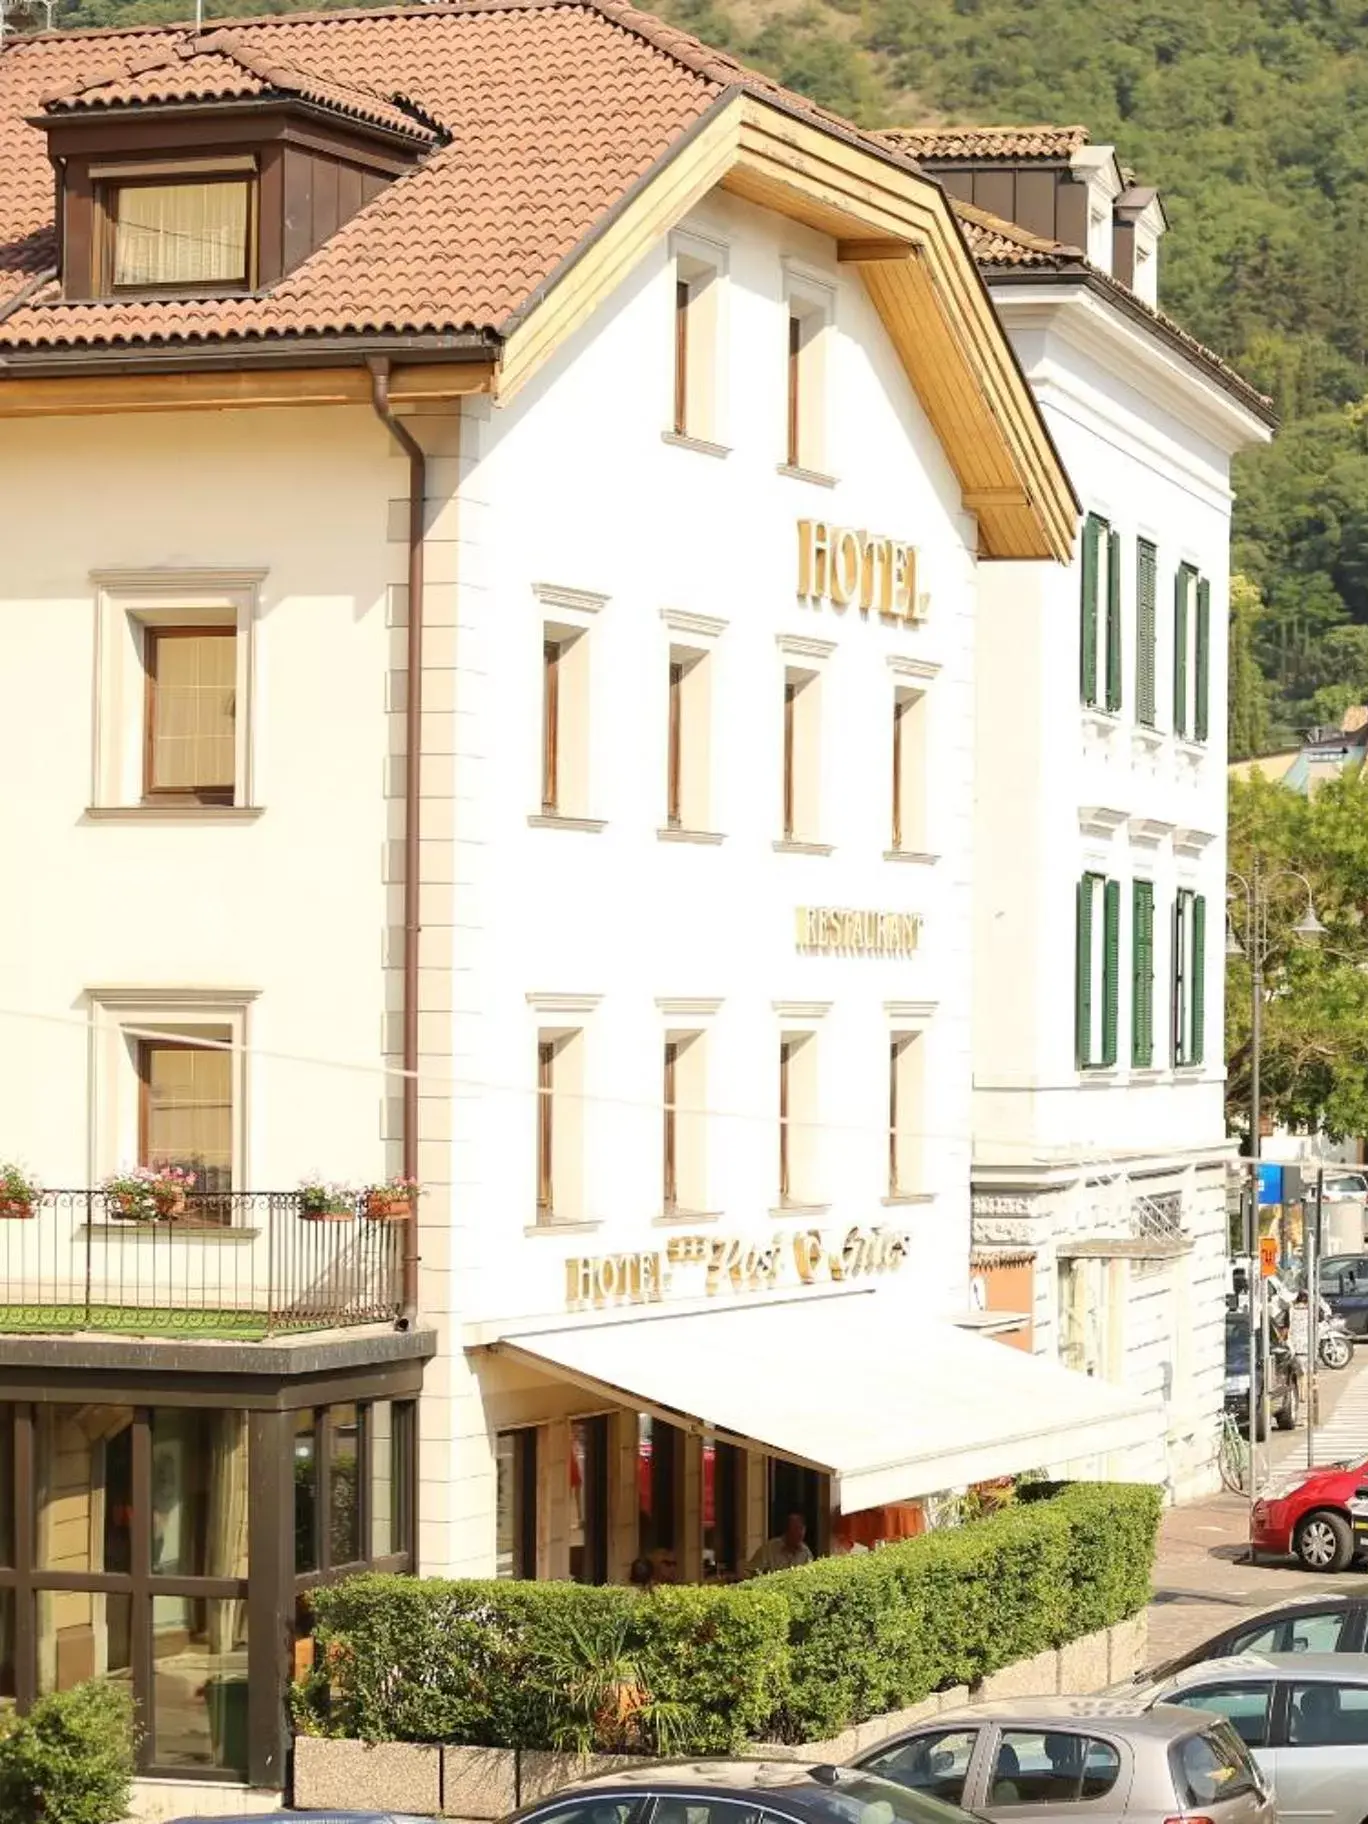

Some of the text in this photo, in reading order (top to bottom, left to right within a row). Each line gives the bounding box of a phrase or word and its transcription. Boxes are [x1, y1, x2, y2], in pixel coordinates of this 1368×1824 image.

[797, 518, 931, 628] HOTEL
[796, 905, 925, 958] RESTAURANT
[565, 1252, 673, 1308] HOTEL
